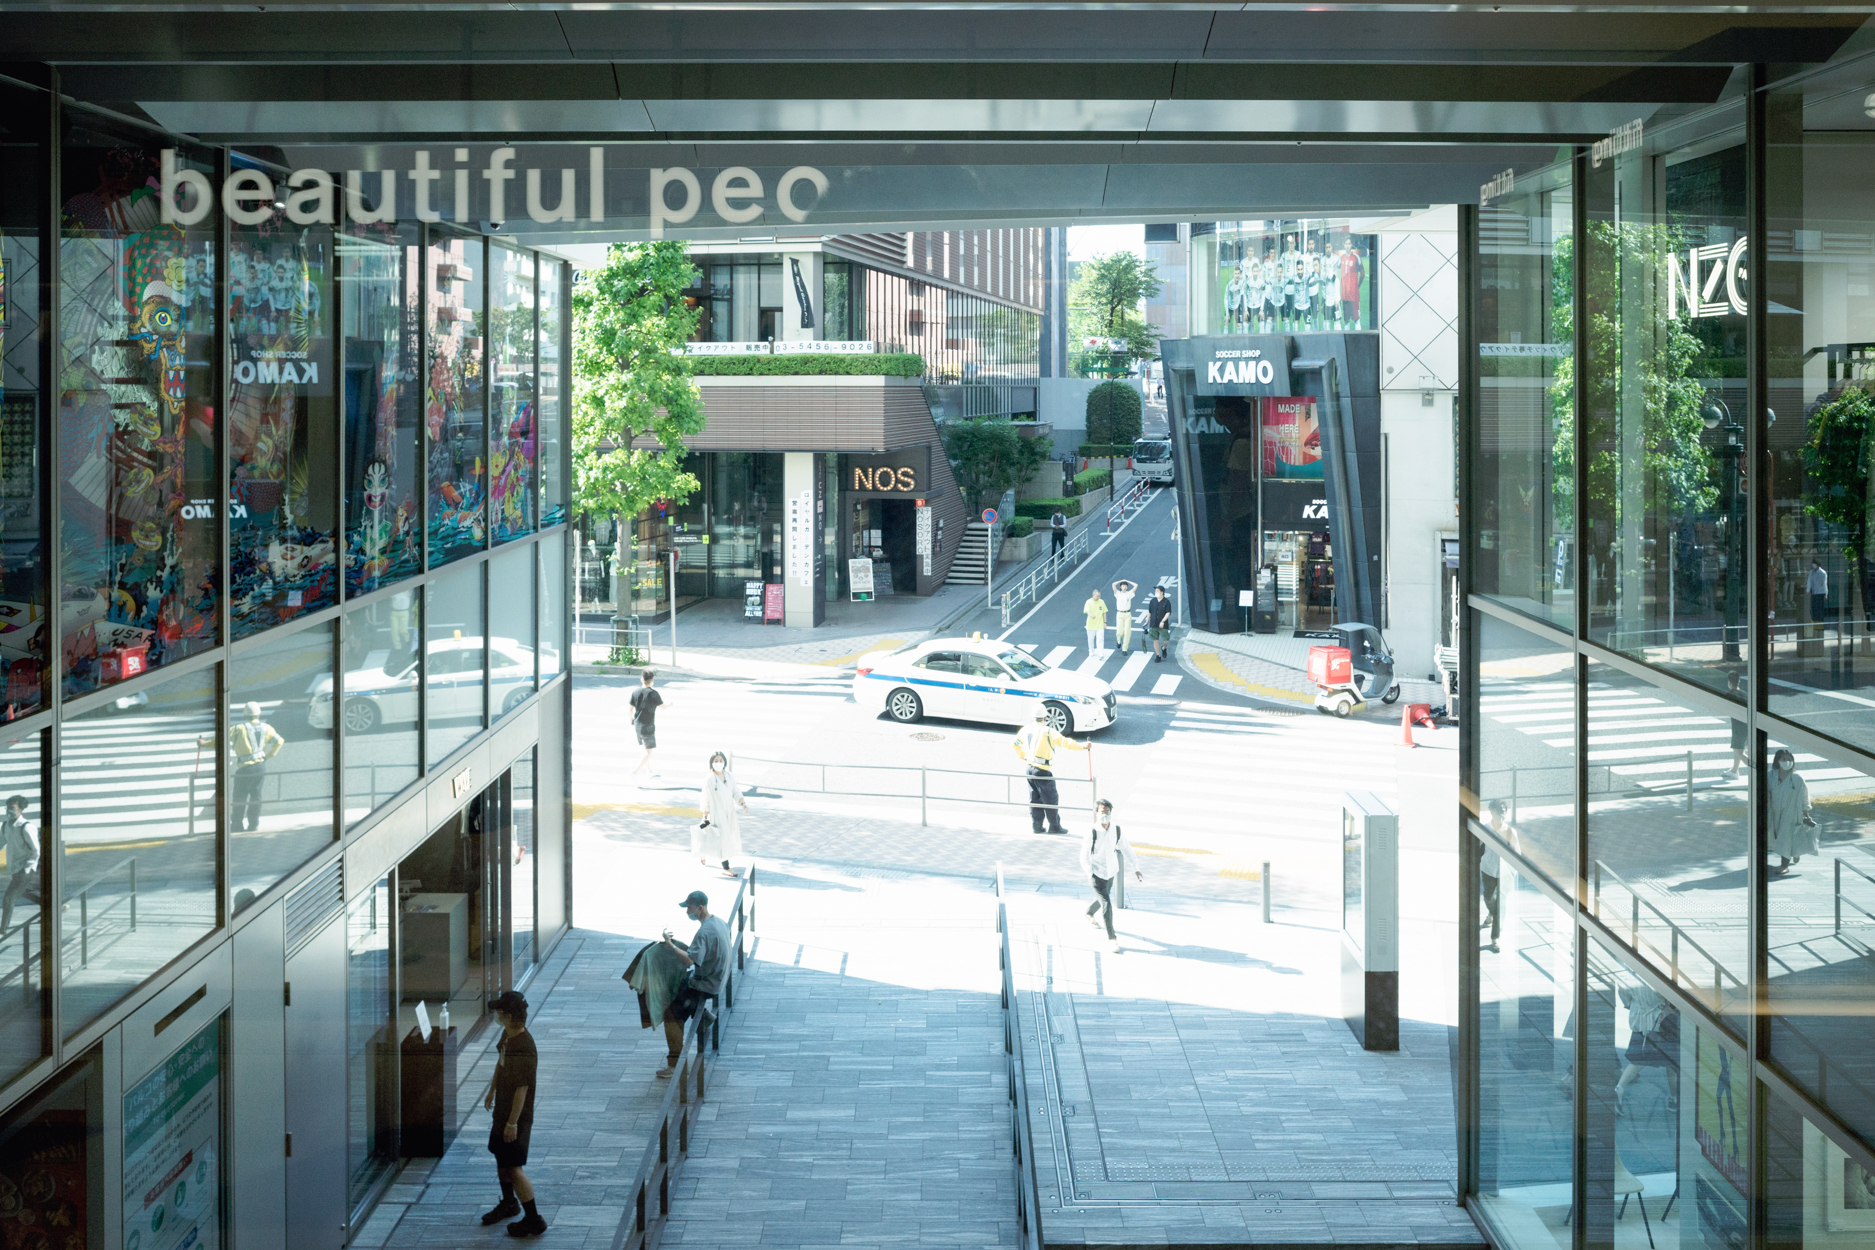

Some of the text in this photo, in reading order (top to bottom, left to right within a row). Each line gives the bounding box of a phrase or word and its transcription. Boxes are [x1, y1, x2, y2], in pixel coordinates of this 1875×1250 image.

[160, 147, 829, 239] beautiful peo
[775, 342, 873, 352] 03-5456-9026
[1215, 349, 1261, 359] SOCCER SHOP
[1207, 359, 1274, 384] KAMO
[1277, 403, 1301, 413] MADE
[1181, 415, 1232, 434] KAM
[1278, 423, 1300, 433] HERE
[854, 466, 916, 491] NOS
[642, 577, 663, 587] SALE
[124, 1048, 213, 1137] り組みとお客様へのお願い
